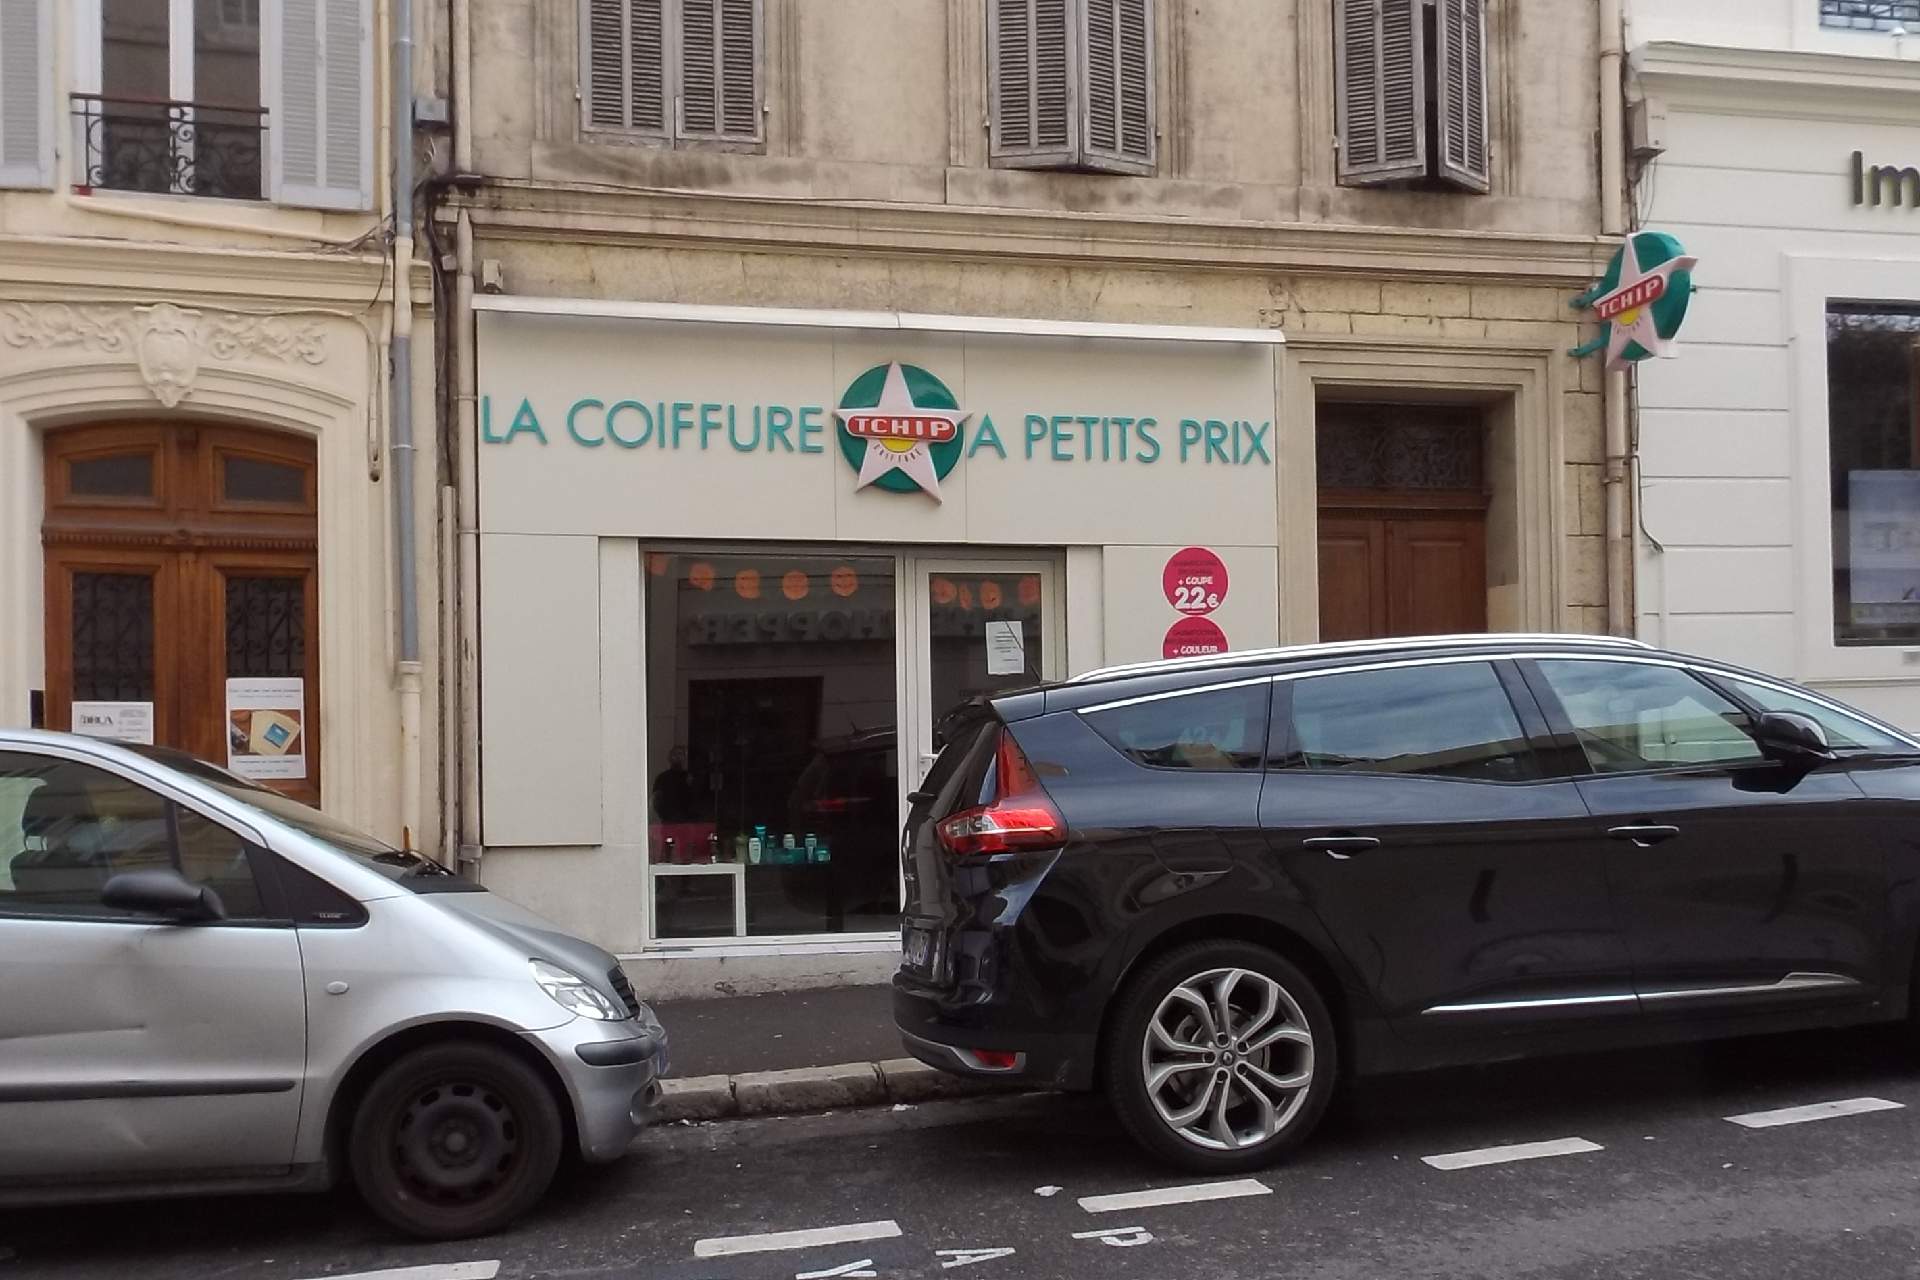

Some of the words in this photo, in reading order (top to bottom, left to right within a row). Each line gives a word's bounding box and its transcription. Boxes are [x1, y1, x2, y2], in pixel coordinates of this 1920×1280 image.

[1851, 149, 1920, 208] Im
[1600, 276, 1660, 319] TCHIP
[481, 394, 548, 445] LA
[566, 398, 825, 453] COIFFURE
[854, 417, 951, 438] TCHIP
[967, 413, 1007, 460] A
[1024, 414, 1161, 464] PETITS
[1179, 418, 1272, 466] PRIX
[1186, 576, 1213, 584] COUPE
[1180, 645, 1218, 654] COULEUR
